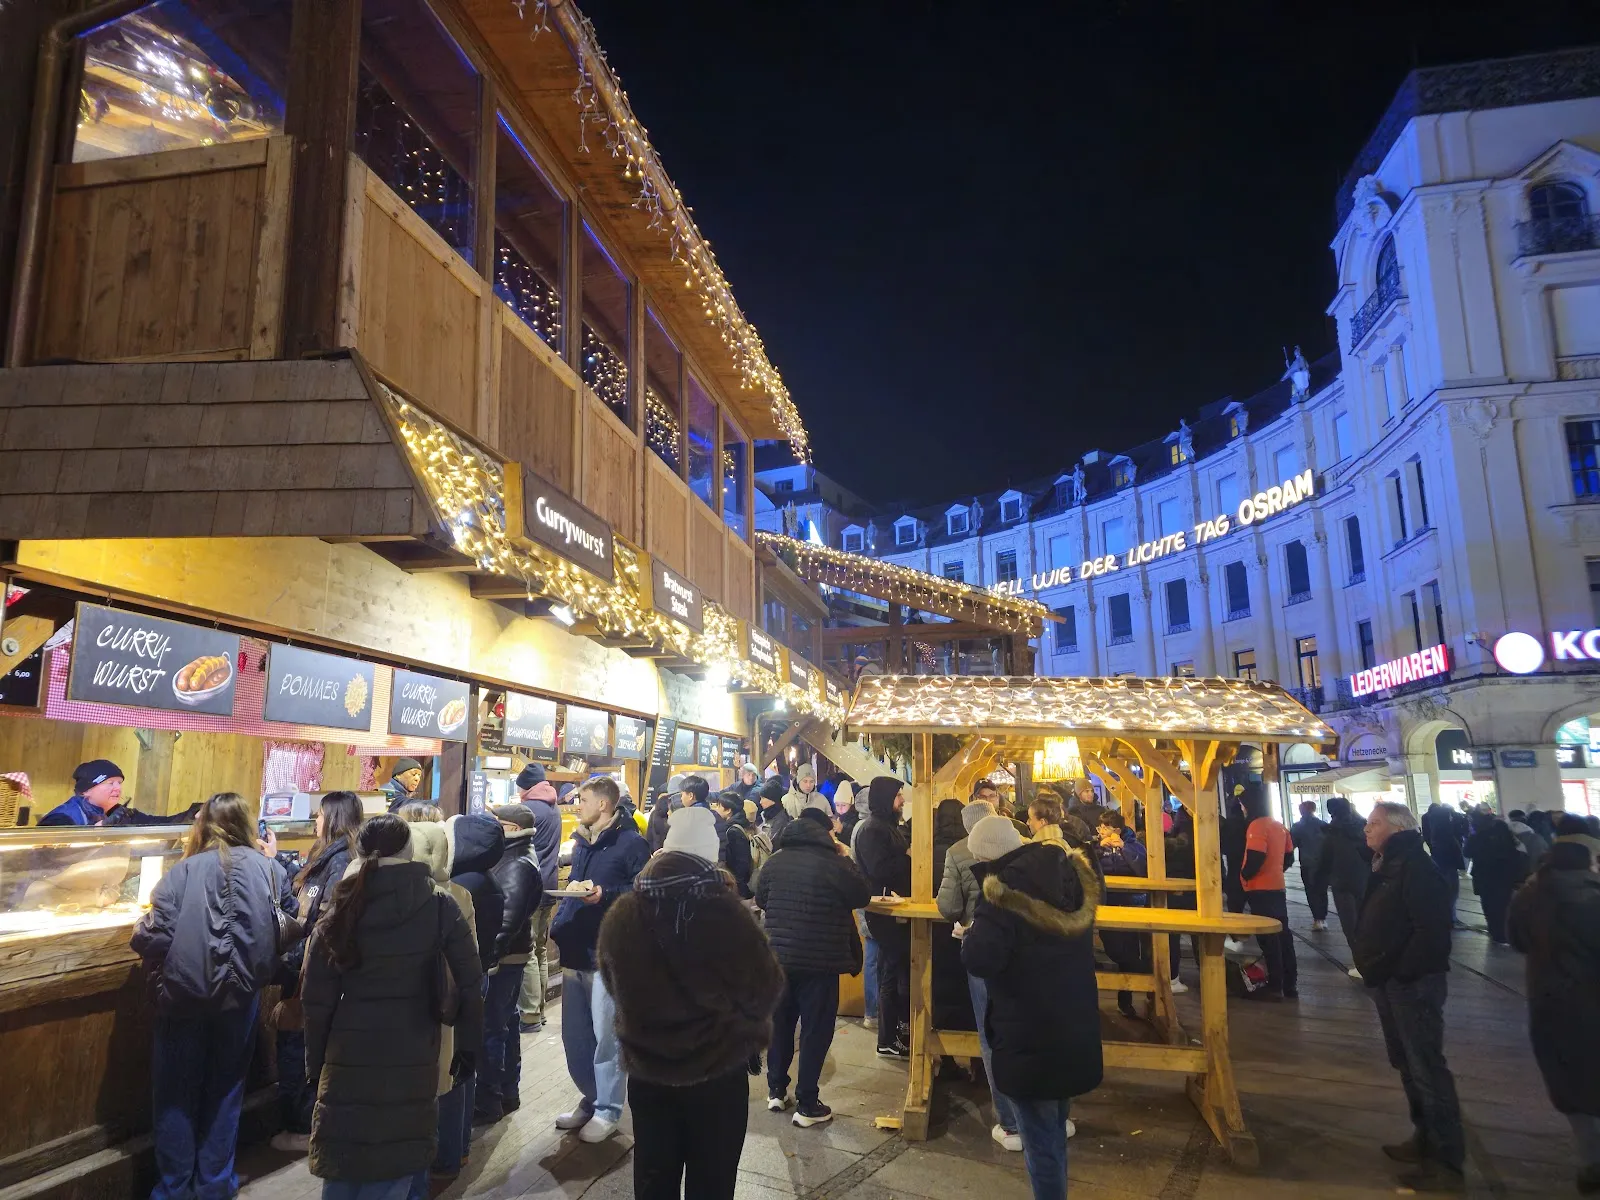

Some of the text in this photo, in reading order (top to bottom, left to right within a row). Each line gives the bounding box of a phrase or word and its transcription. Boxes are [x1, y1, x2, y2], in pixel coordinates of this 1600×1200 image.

[536, 496, 604, 558] Currywurst
[1032, 566, 1071, 590] WIE
[1081, 553, 1118, 580] DER
[1128, 530, 1186, 566] LICHTE
[1194, 514, 1230, 545] TAG
[1238, 469, 1314, 525] OSRAM
[663, 571, 694, 604] Bratwurst
[96, 624, 172, 660] CURRY-
[14, 669, 31, 678] 6,00
[93, 660, 166, 694] WURST
[280, 673, 338, 701] POMMES
[1351, 644, 1447, 697] LEDERWAREN
[402, 683, 437, 703] CURRY-
[401, 705, 435, 726] WURST
[1293, 784, 1330, 793] Lederwaren
